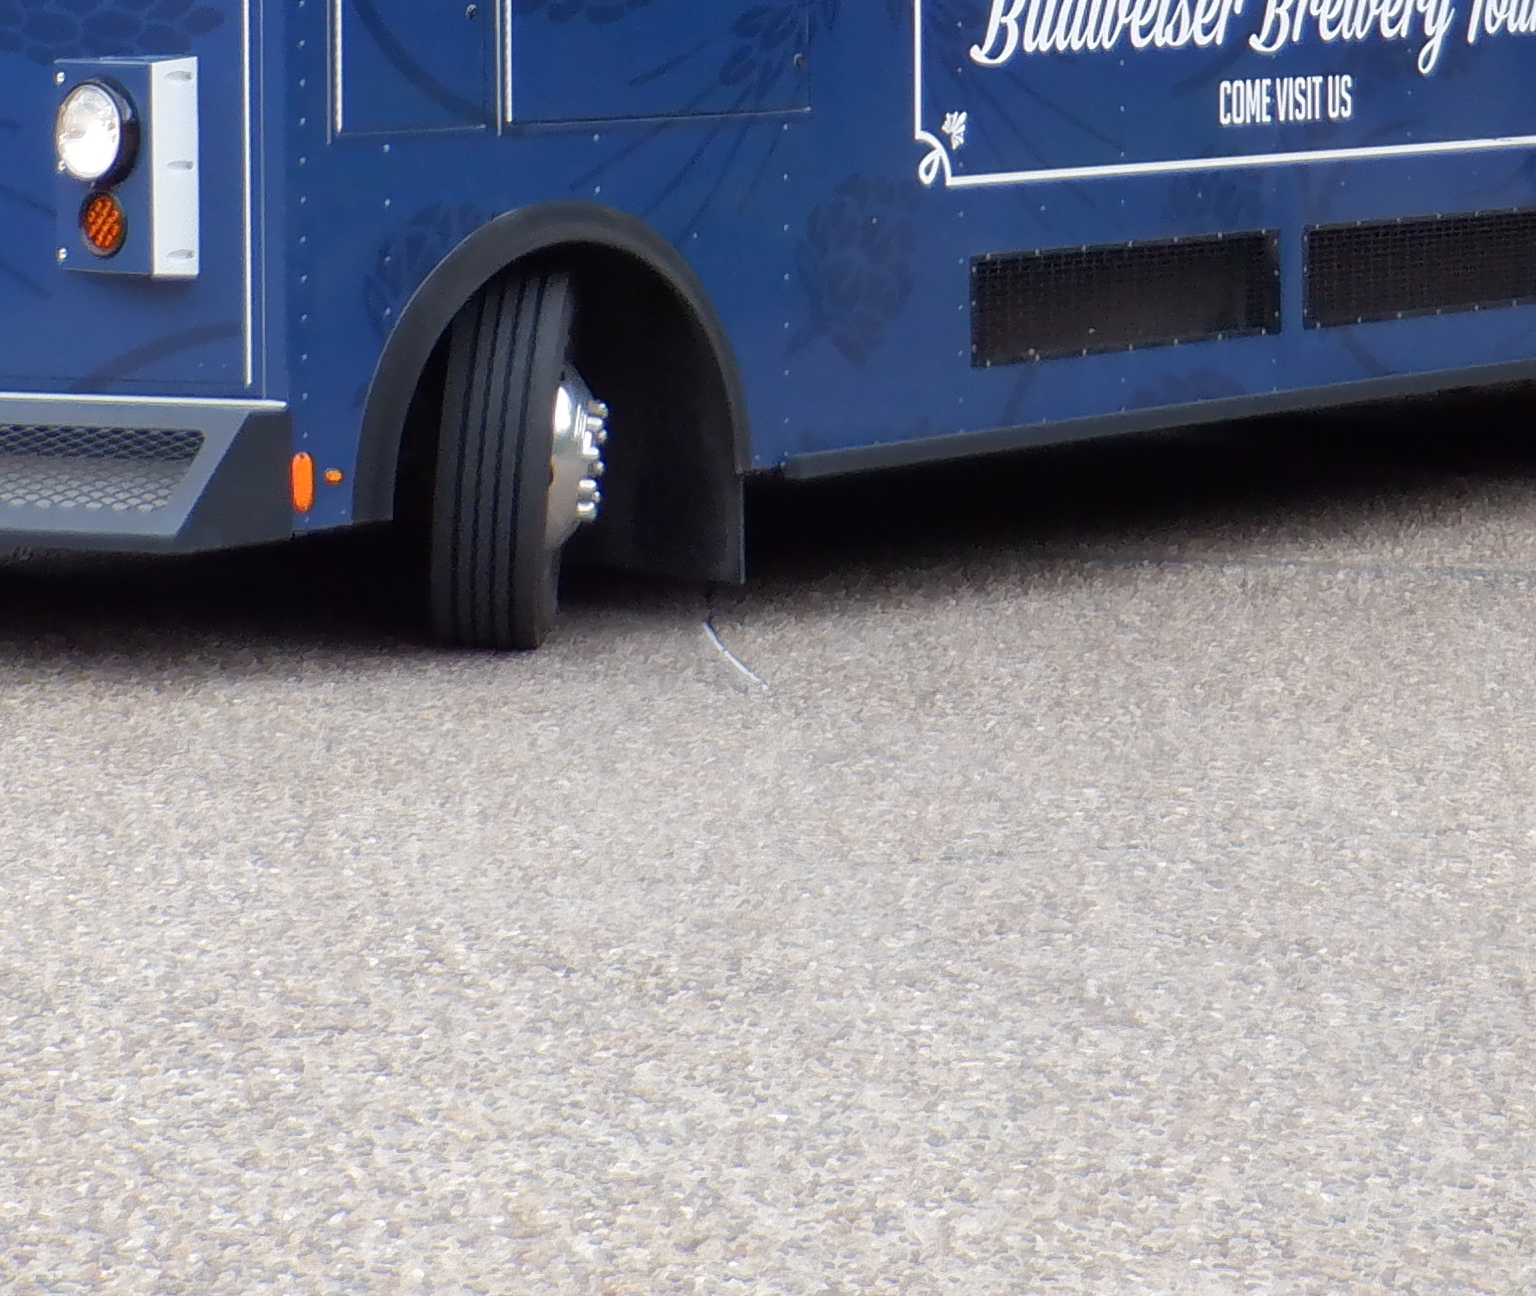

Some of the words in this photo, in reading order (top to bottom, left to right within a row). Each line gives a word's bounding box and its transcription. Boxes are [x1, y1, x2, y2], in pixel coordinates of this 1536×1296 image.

[1219, 79, 1272, 125] COME
[1275, 75, 1323, 122] VISIT
[1327, 74, 1352, 119] US
